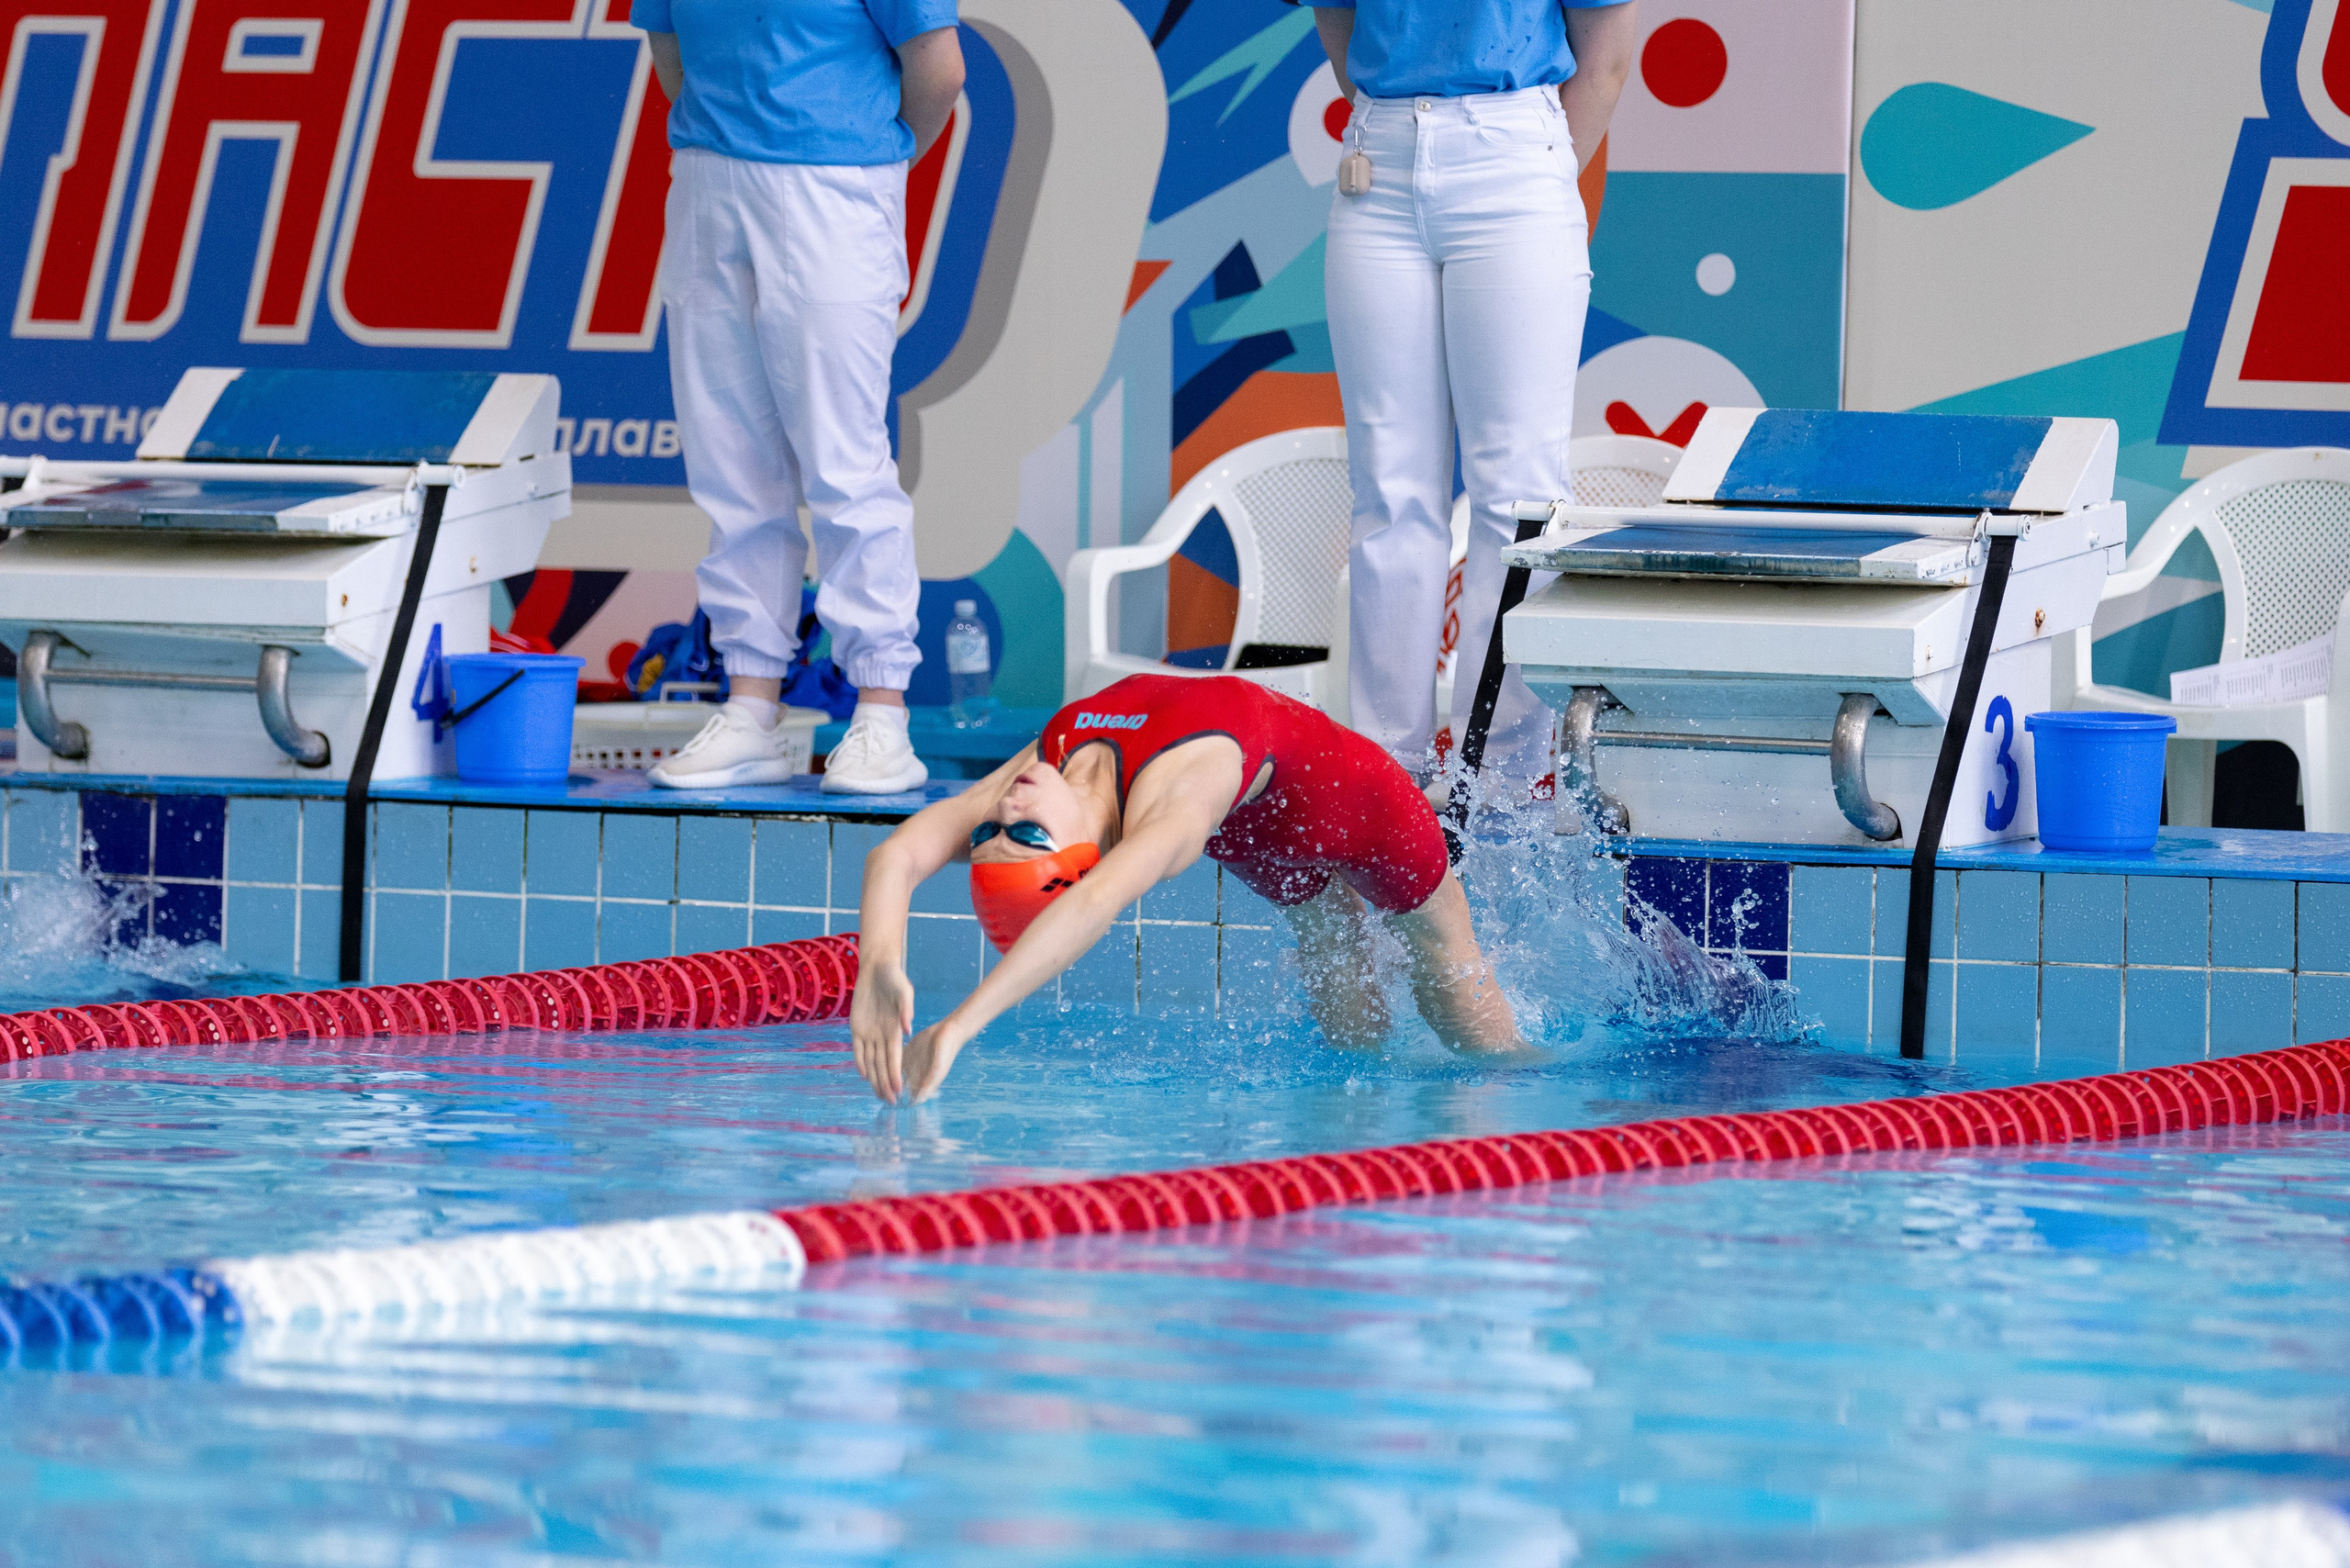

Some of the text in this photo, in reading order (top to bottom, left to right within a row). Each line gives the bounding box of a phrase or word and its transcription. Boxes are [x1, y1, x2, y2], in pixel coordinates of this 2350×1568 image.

[411, 623, 449, 745] 4
[1074, 711, 1148, 730] arena
[1985, 695, 2020, 832] 3
